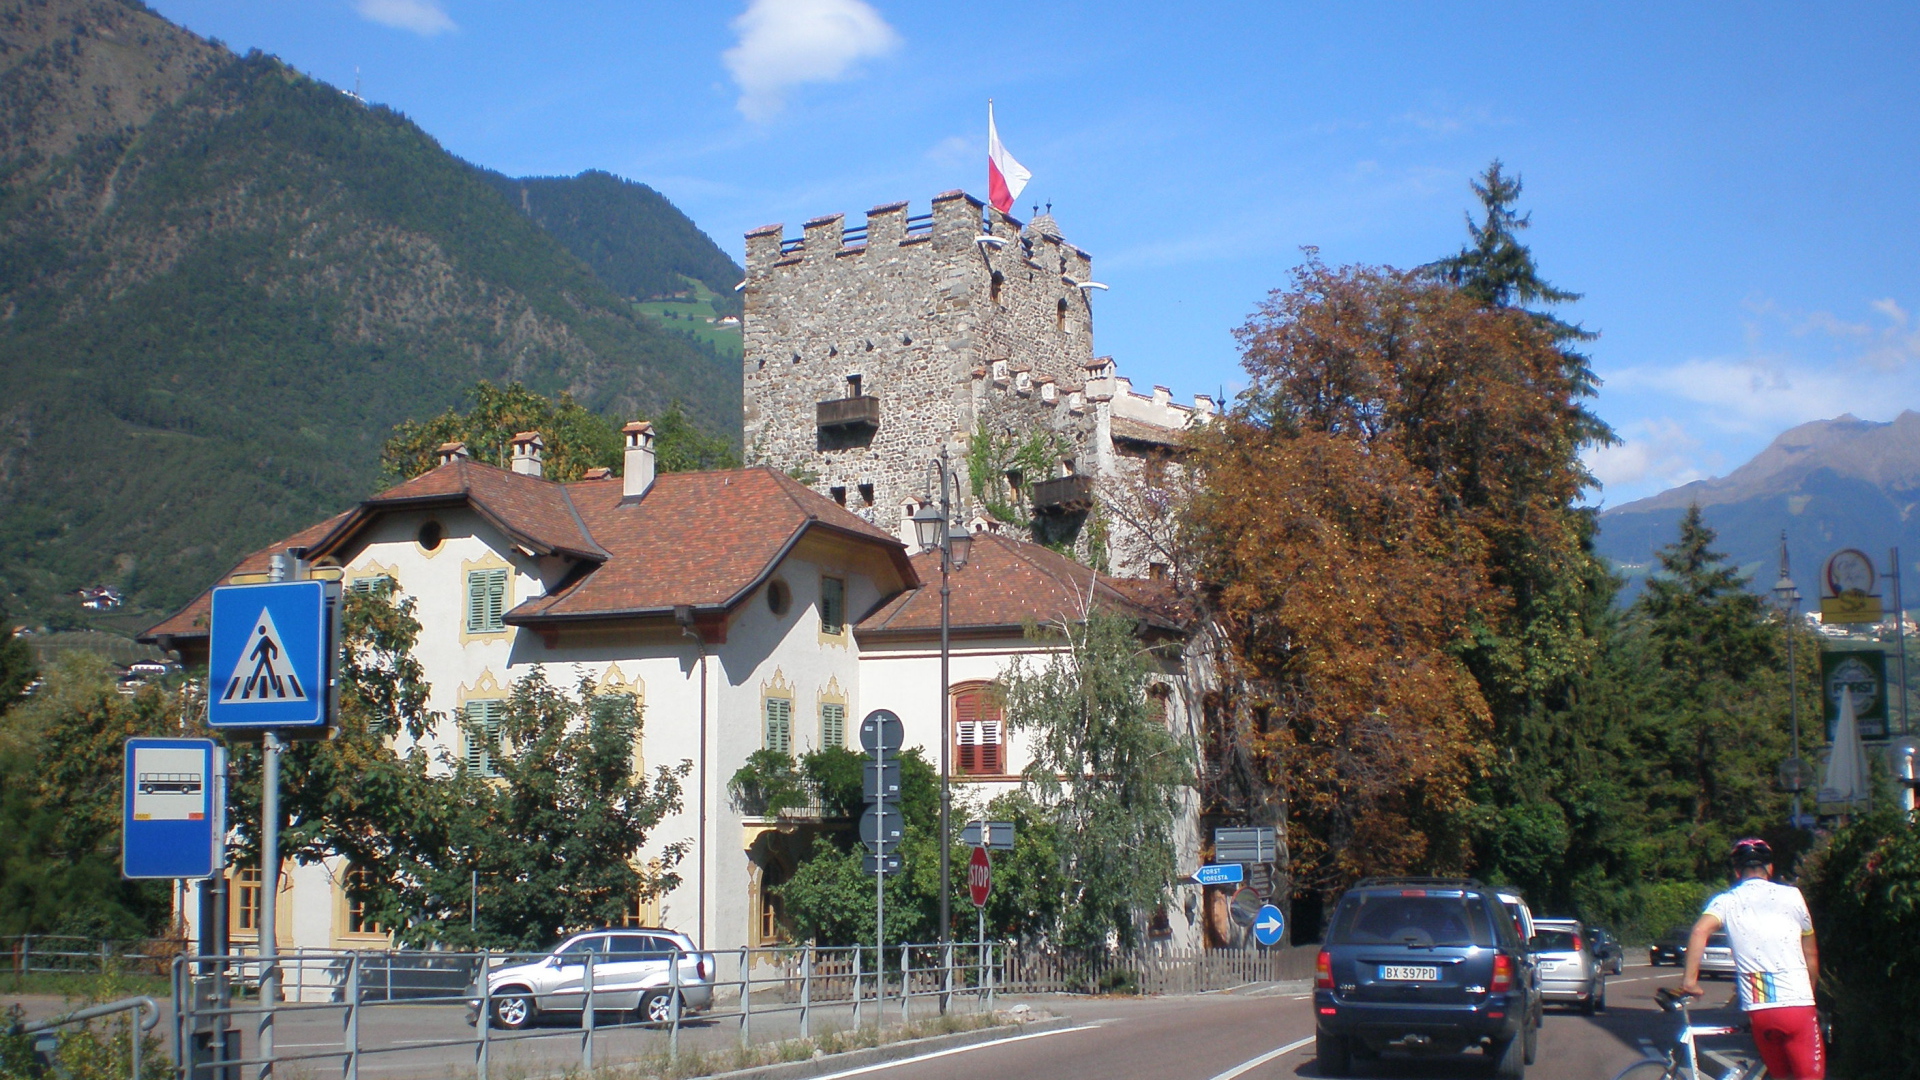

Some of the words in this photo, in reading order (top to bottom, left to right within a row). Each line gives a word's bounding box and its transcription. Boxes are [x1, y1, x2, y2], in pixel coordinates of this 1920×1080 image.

[970, 864, 989, 888] STOP
[1386, 967, 1399, 978] BX
[1402, 967, 1435, 979] 397PD
